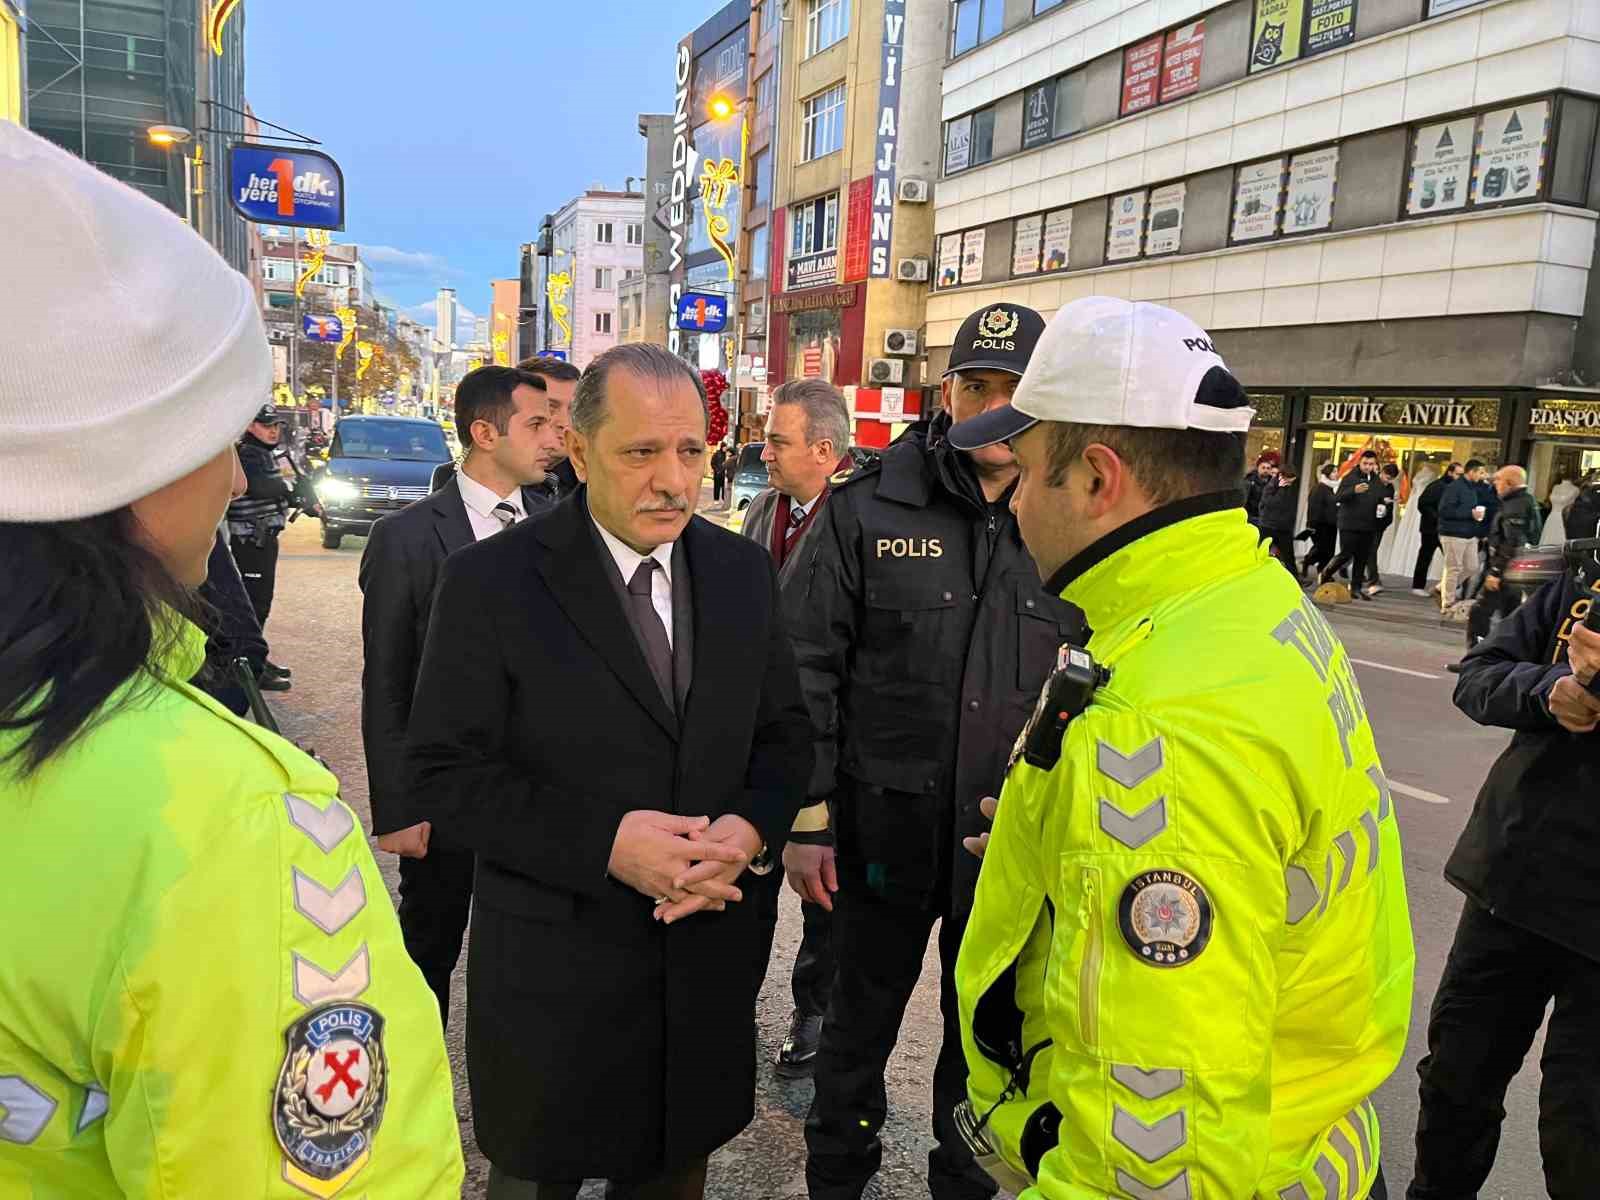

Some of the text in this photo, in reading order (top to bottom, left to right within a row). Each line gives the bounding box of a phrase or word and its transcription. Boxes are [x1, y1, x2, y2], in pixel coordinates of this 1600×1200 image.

[1316, 12, 1343, 30] FOTO
[669, 46, 690, 272] WEDDING
[240, 187, 278, 203] yere
[248, 173, 278, 190] her
[267, 158, 295, 216] 1
[871, 107, 896, 275] AJANS
[1322, 396, 1600, 428] BUTİK ANTİK EDASPO
